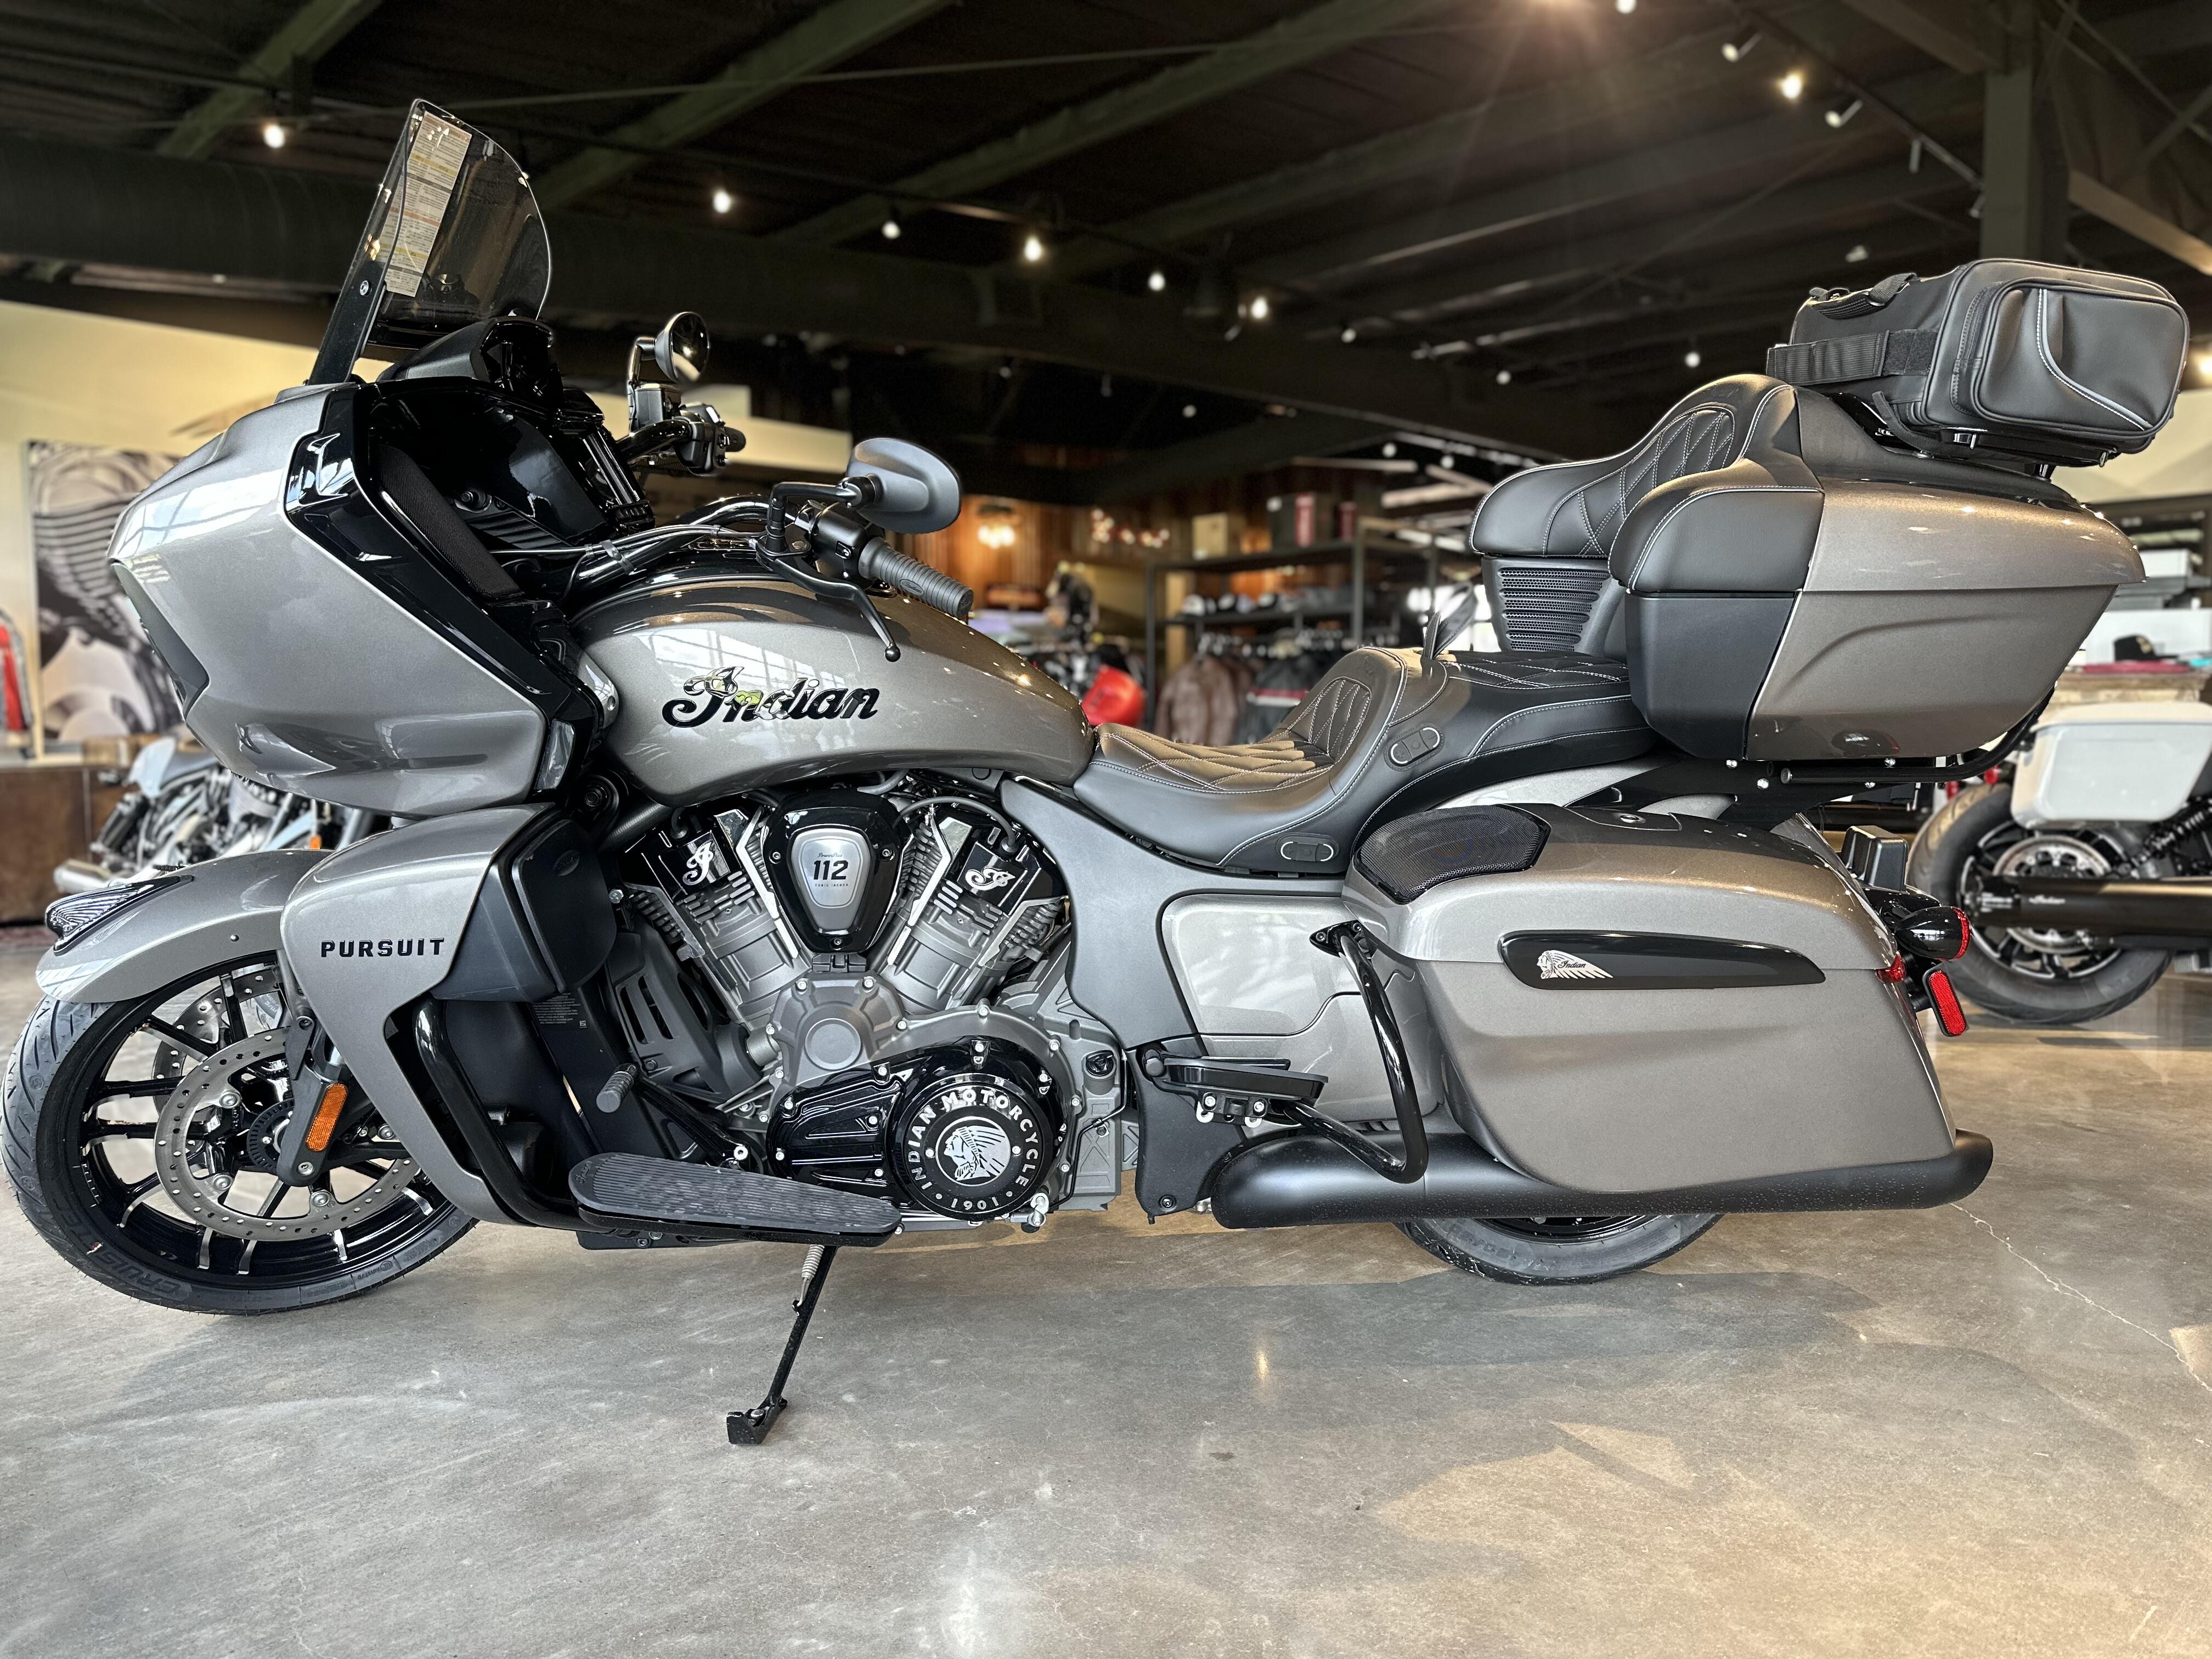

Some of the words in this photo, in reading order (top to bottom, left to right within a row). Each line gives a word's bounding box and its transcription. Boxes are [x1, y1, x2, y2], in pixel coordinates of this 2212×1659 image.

[662, 666, 880, 727] Indian
[813, 860, 849, 880] 112
[321, 937, 445, 958] PURSUIT
[1557, 960, 1587, 968] Indian
[908, 1104, 936, 1190] INDIAN
[941, 1088, 1039, 1187] MOTORCYCLE
[951, 1196, 1000, 1210] 1901
